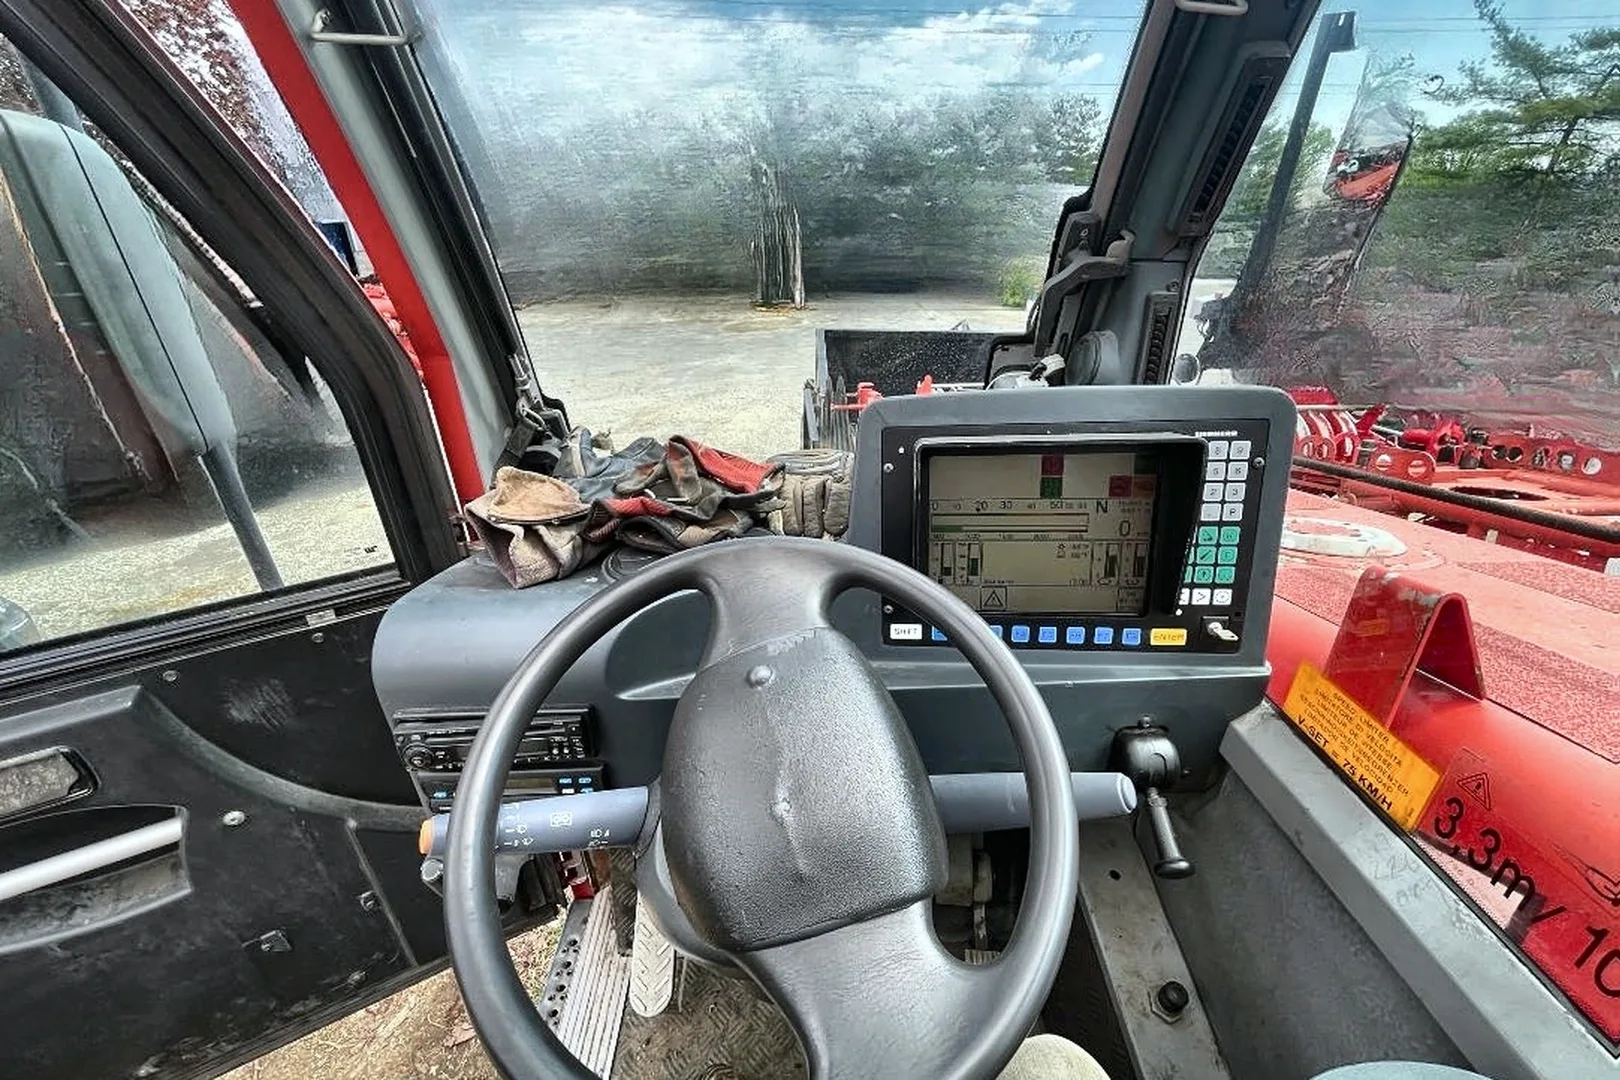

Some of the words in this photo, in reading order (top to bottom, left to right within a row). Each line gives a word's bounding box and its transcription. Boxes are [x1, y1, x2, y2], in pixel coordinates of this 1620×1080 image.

[1096, 499, 1108, 514] N
[894, 627, 918, 635] SHIFT
[1297, 714, 1329, 748] V-SET
[1343, 758, 1357, 777] 75
[1358, 774, 1393, 811] KM/H
